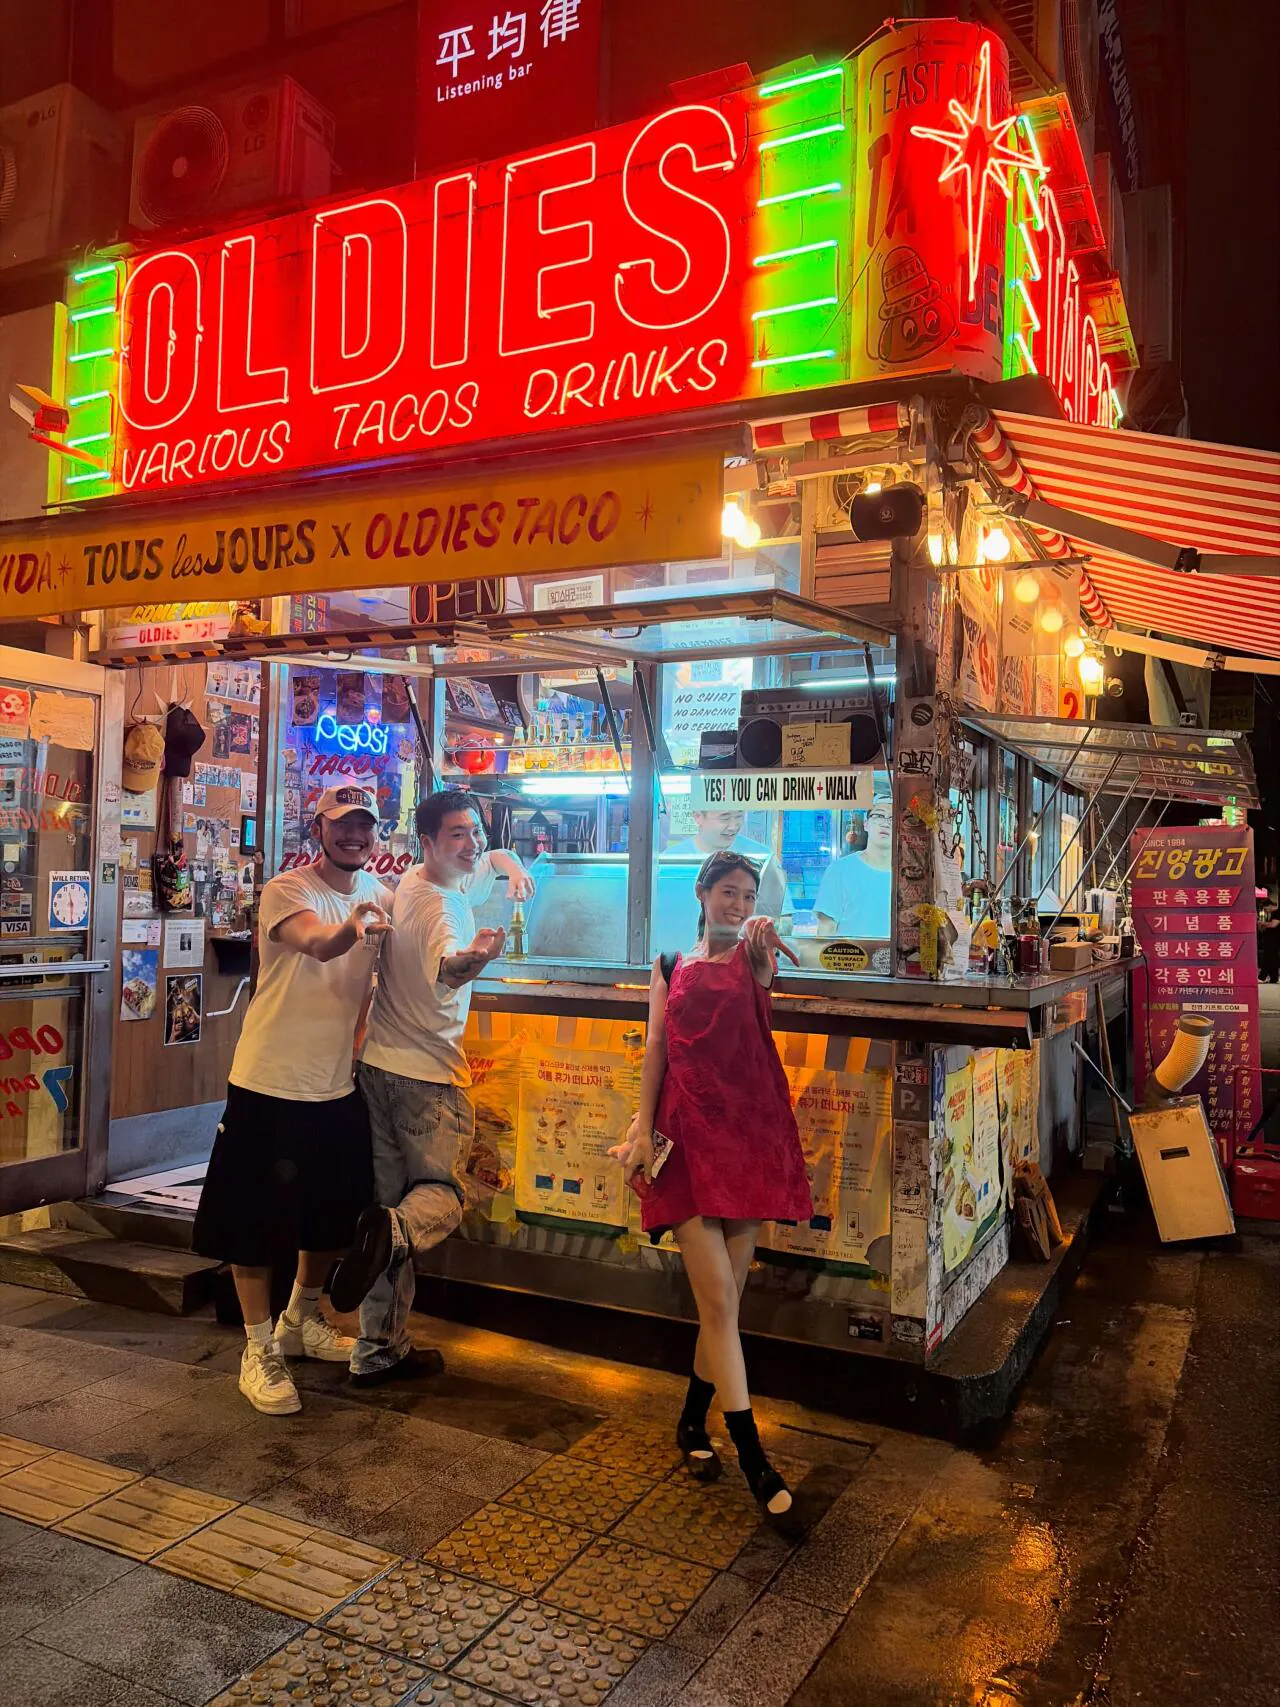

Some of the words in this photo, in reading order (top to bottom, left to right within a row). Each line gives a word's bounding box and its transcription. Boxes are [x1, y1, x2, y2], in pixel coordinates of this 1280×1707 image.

[437, 72, 502, 102] Listening
[508, 62, 533, 81] bar
[883, 60, 944, 115] EAST
[120, 104, 737, 430] OLDIES
[122, 420, 290, 489] VARIOUS
[333, 381, 480, 450] TACOS
[523, 339, 728, 418] DRINKS
[83, 537, 165, 586] TOUS
[171, 533, 203, 580] les
[203, 518, 317, 575] JOURS
[364, 500, 506, 560] OLDIES
[512, 490, 621, 546] TACO
[411, 577, 505, 625] OPEN
[674, 694, 693, 704] NO
[696, 692, 737, 703] SHIRT
[673, 709, 689, 717] NO
[689, 707, 737, 717] DANCING
[674, 722, 690, 732] NO
[690, 722, 736, 732] SERVICE
[308, 753, 391, 777] TACOS
[704, 777, 726, 802] YES!
[731, 777, 751, 801] YOU
[756, 776, 777, 801] CAN
[1136, 847, 1249, 881] 진영광고
[69, 874, 90, 882] RETURN
[1152, 889, 1232, 906] 판촉용품
[5, 922, 28, 932] VISA
[1153, 915, 1233, 932] 기념품
[1154, 941, 1234, 958] 행사용품
[1154, 967, 1234, 984] 각종인쇄
[555, 1072, 571, 1085] 휴가
[572, 1075, 602, 1088] 떠나자!
[821, 1099, 855, 1114] 떠나자!
